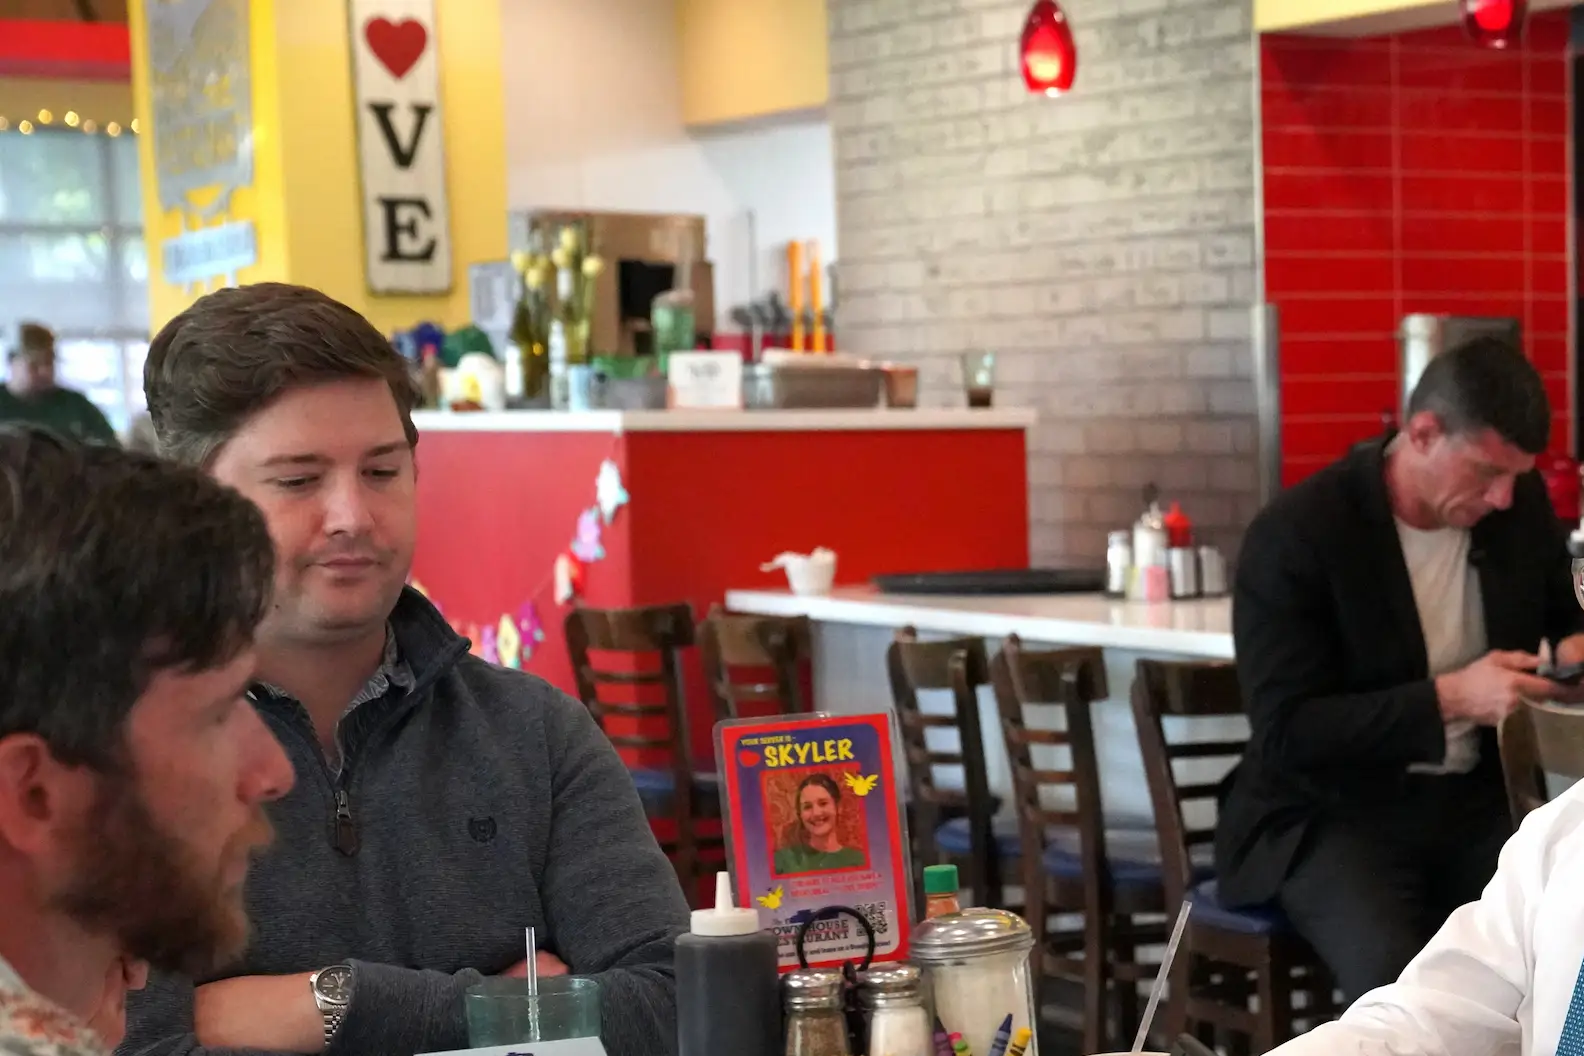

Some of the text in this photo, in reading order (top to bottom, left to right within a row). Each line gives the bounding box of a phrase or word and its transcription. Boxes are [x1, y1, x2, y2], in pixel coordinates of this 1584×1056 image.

[764, 738, 855, 768] SKYLER
[773, 924, 802, 936] OWN
[777, 930, 849, 947] ESTURANT
